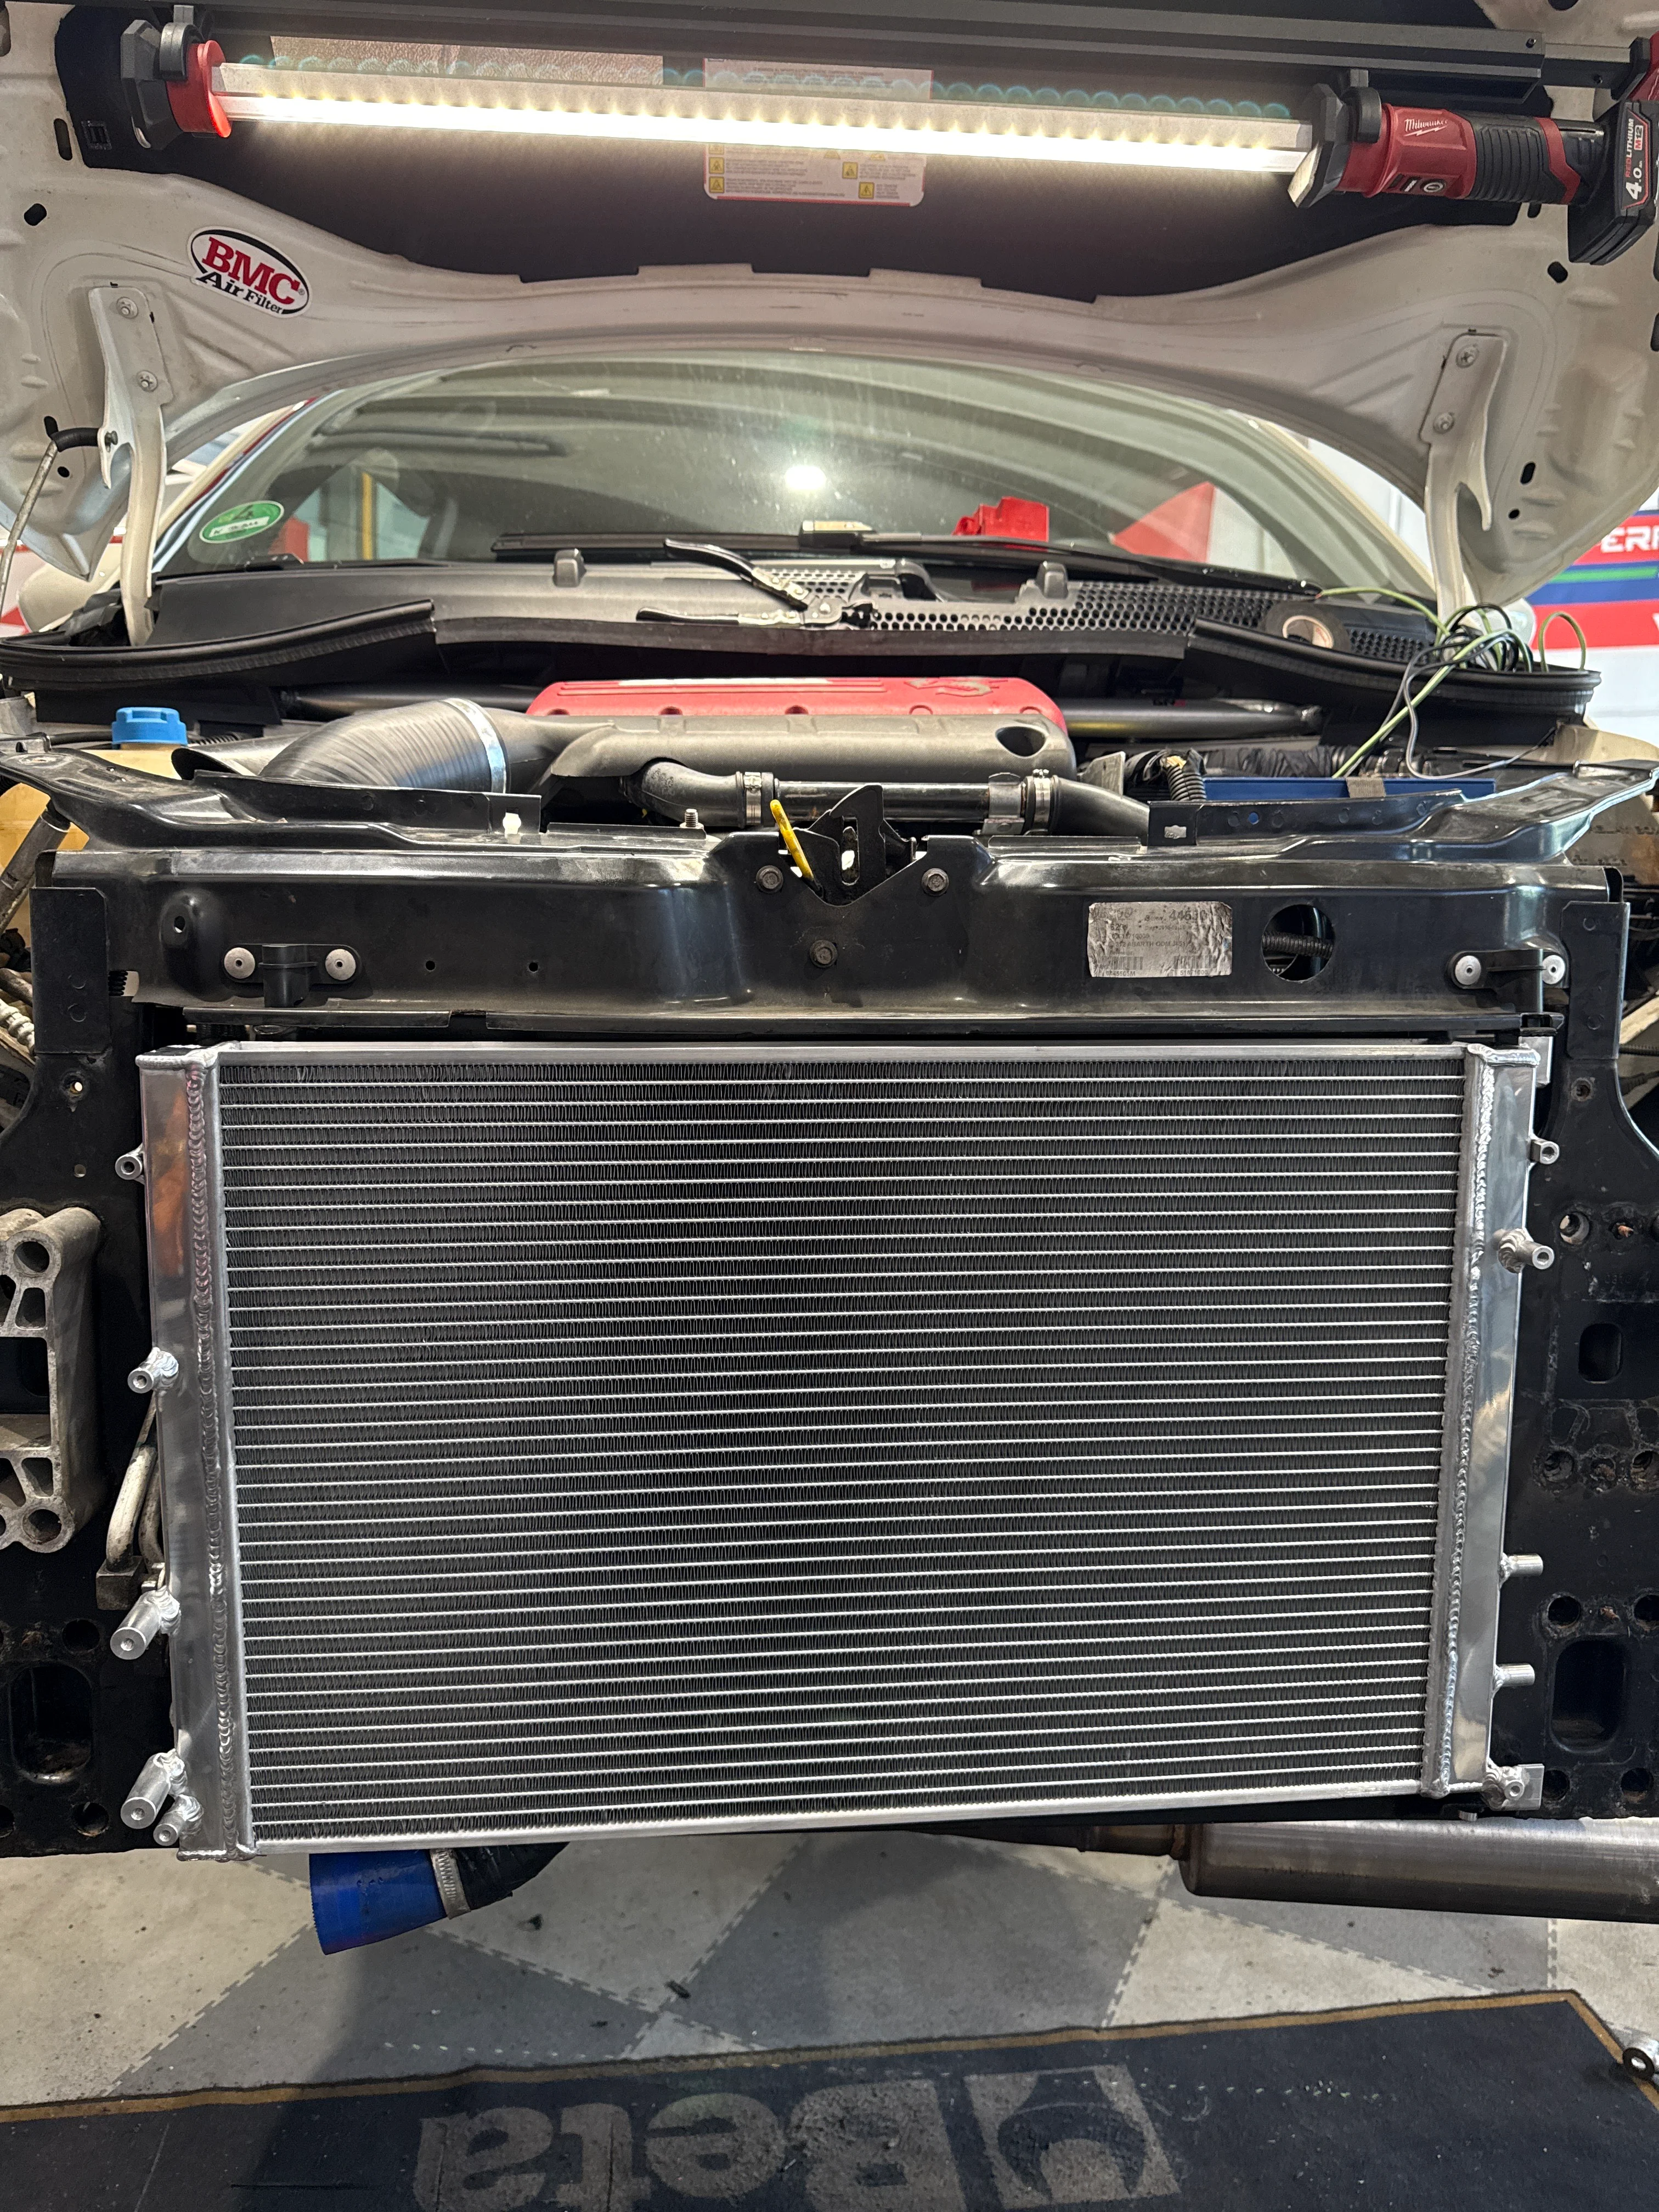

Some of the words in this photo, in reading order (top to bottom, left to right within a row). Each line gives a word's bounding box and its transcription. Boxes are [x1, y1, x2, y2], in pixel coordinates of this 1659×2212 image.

[1625, 118, 1634, 178] REDLITHIUM
[195, 272, 244, 297] Air
[243, 288, 283, 314] Filter
[201, 236, 301, 305] BMC
[412, 2078, 968, 2212] Beta
